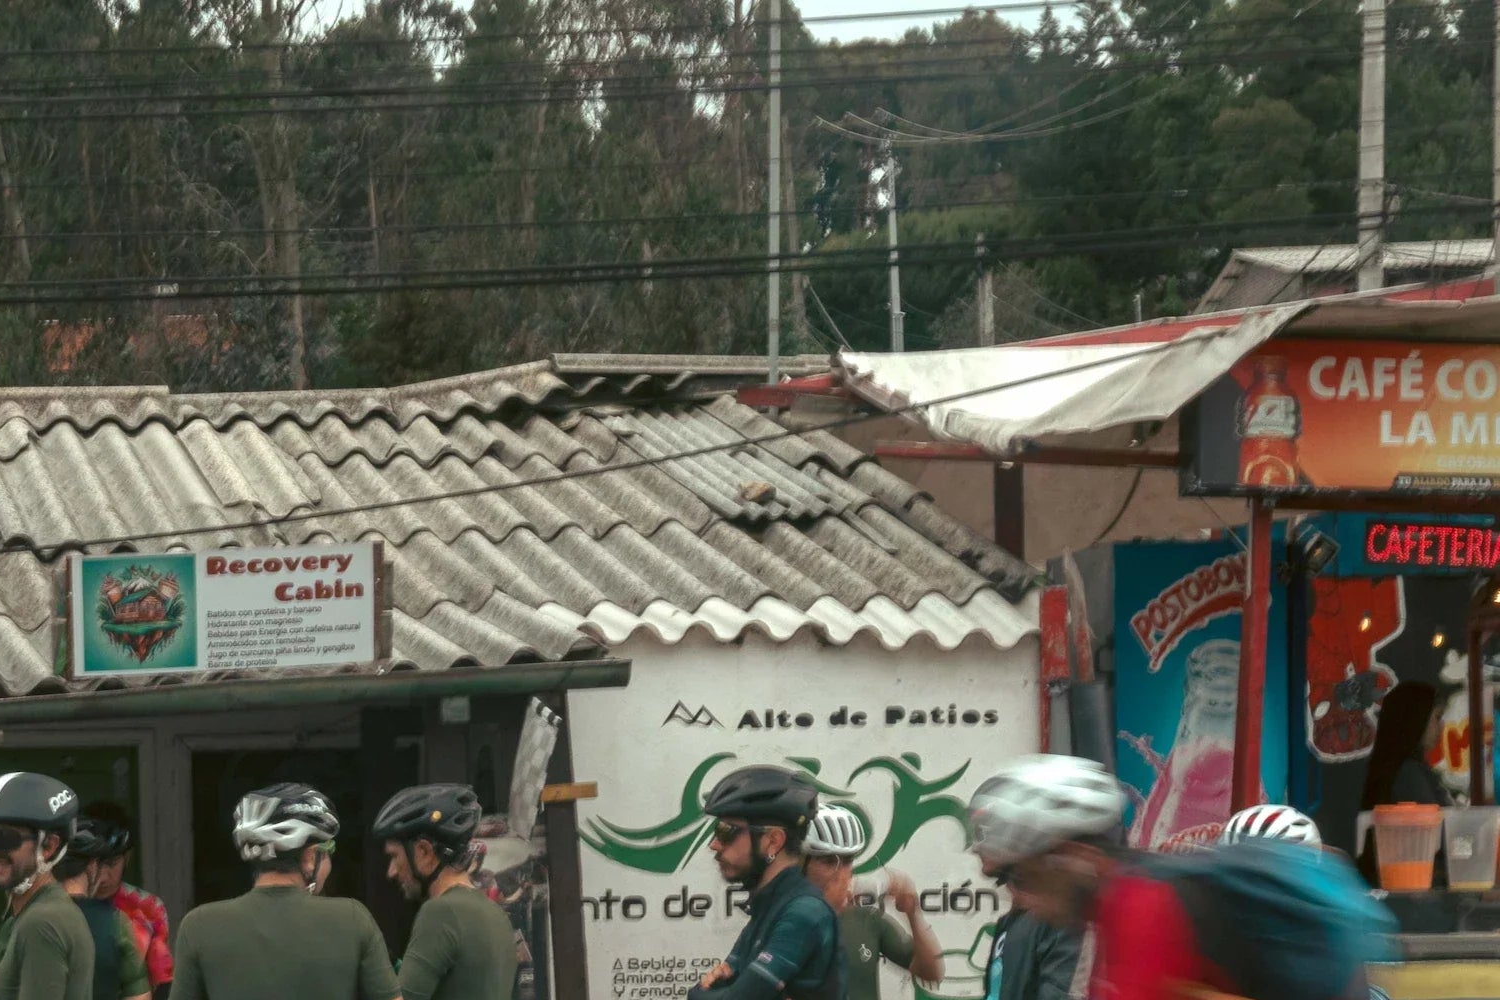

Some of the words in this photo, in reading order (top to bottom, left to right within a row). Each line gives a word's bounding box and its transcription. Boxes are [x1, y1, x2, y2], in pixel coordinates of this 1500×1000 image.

[1308, 350, 1425, 400] CAFÉ
[1435, 358, 1498, 401] CO
[1380, 410, 1436, 445] LA
[206, 552, 354, 577] Recovery
[274, 577, 365, 602] Cabin
[736, 708, 815, 730] Alto
[828, 705, 868, 727] de
[883, 703, 999, 727] Patios
[662, 884, 713, 918] de
[627, 956, 687, 971] Bebida
[690, 957, 721, 968] con
[613, 968, 706, 985] Aminoácid
[630, 983, 688, 998] remola
